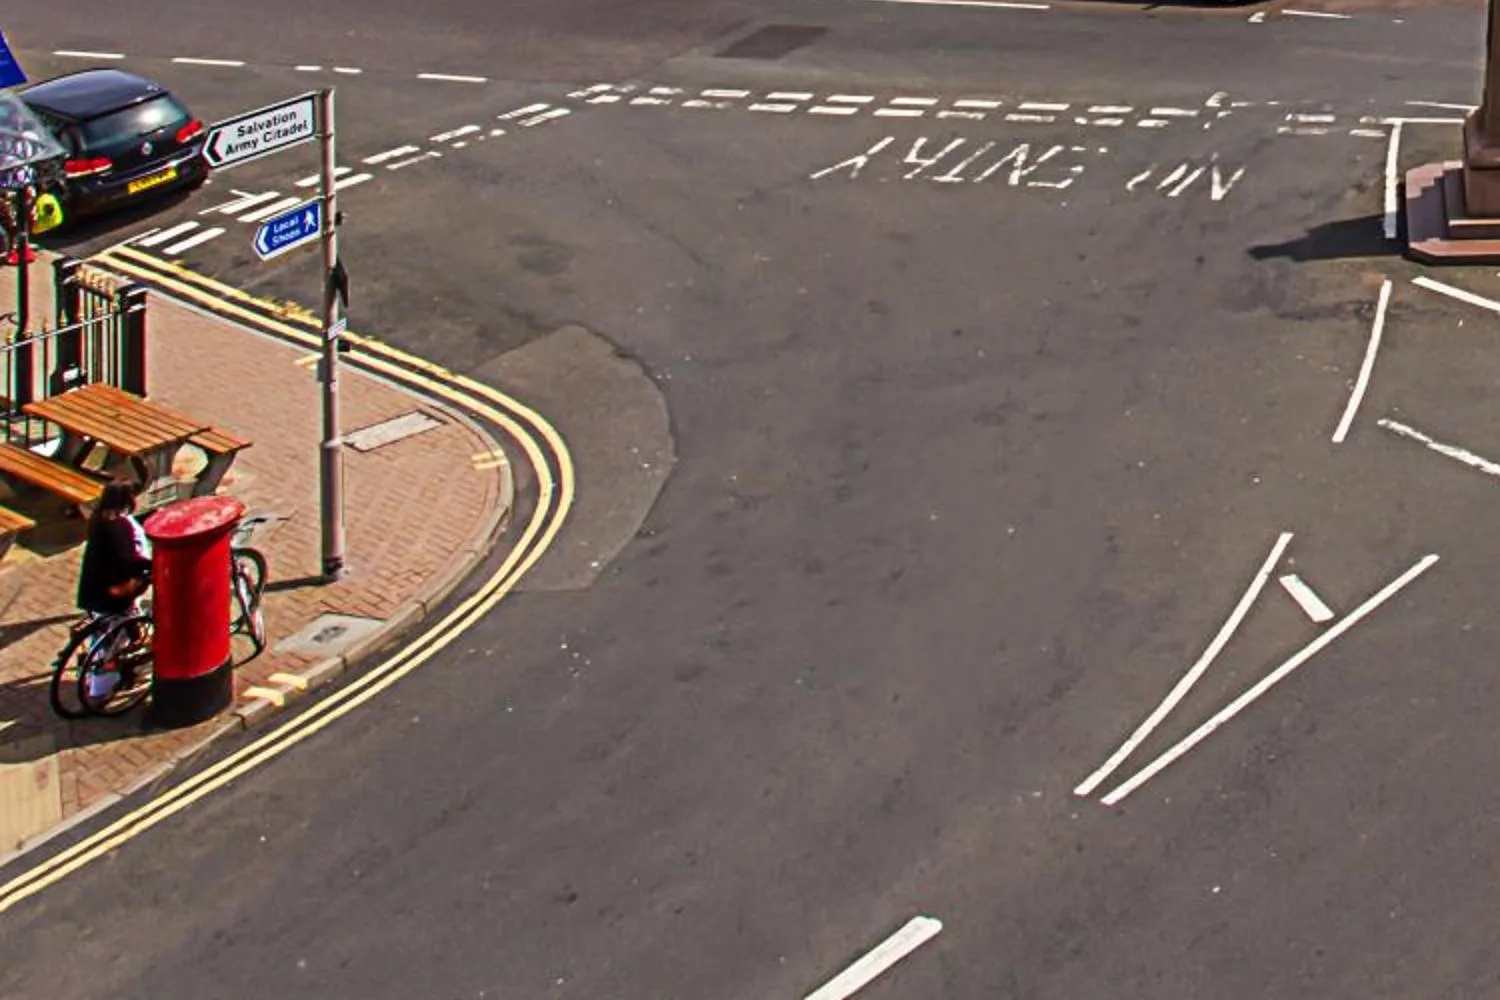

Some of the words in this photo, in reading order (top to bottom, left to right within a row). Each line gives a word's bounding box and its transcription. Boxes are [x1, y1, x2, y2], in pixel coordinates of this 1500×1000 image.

[236, 109, 298, 138] Salvation
[225, 136, 260, 156] Army
[262, 119, 309, 143] Citadel
[273, 215, 300, 231] Local
[271, 227, 302, 247] Shops
